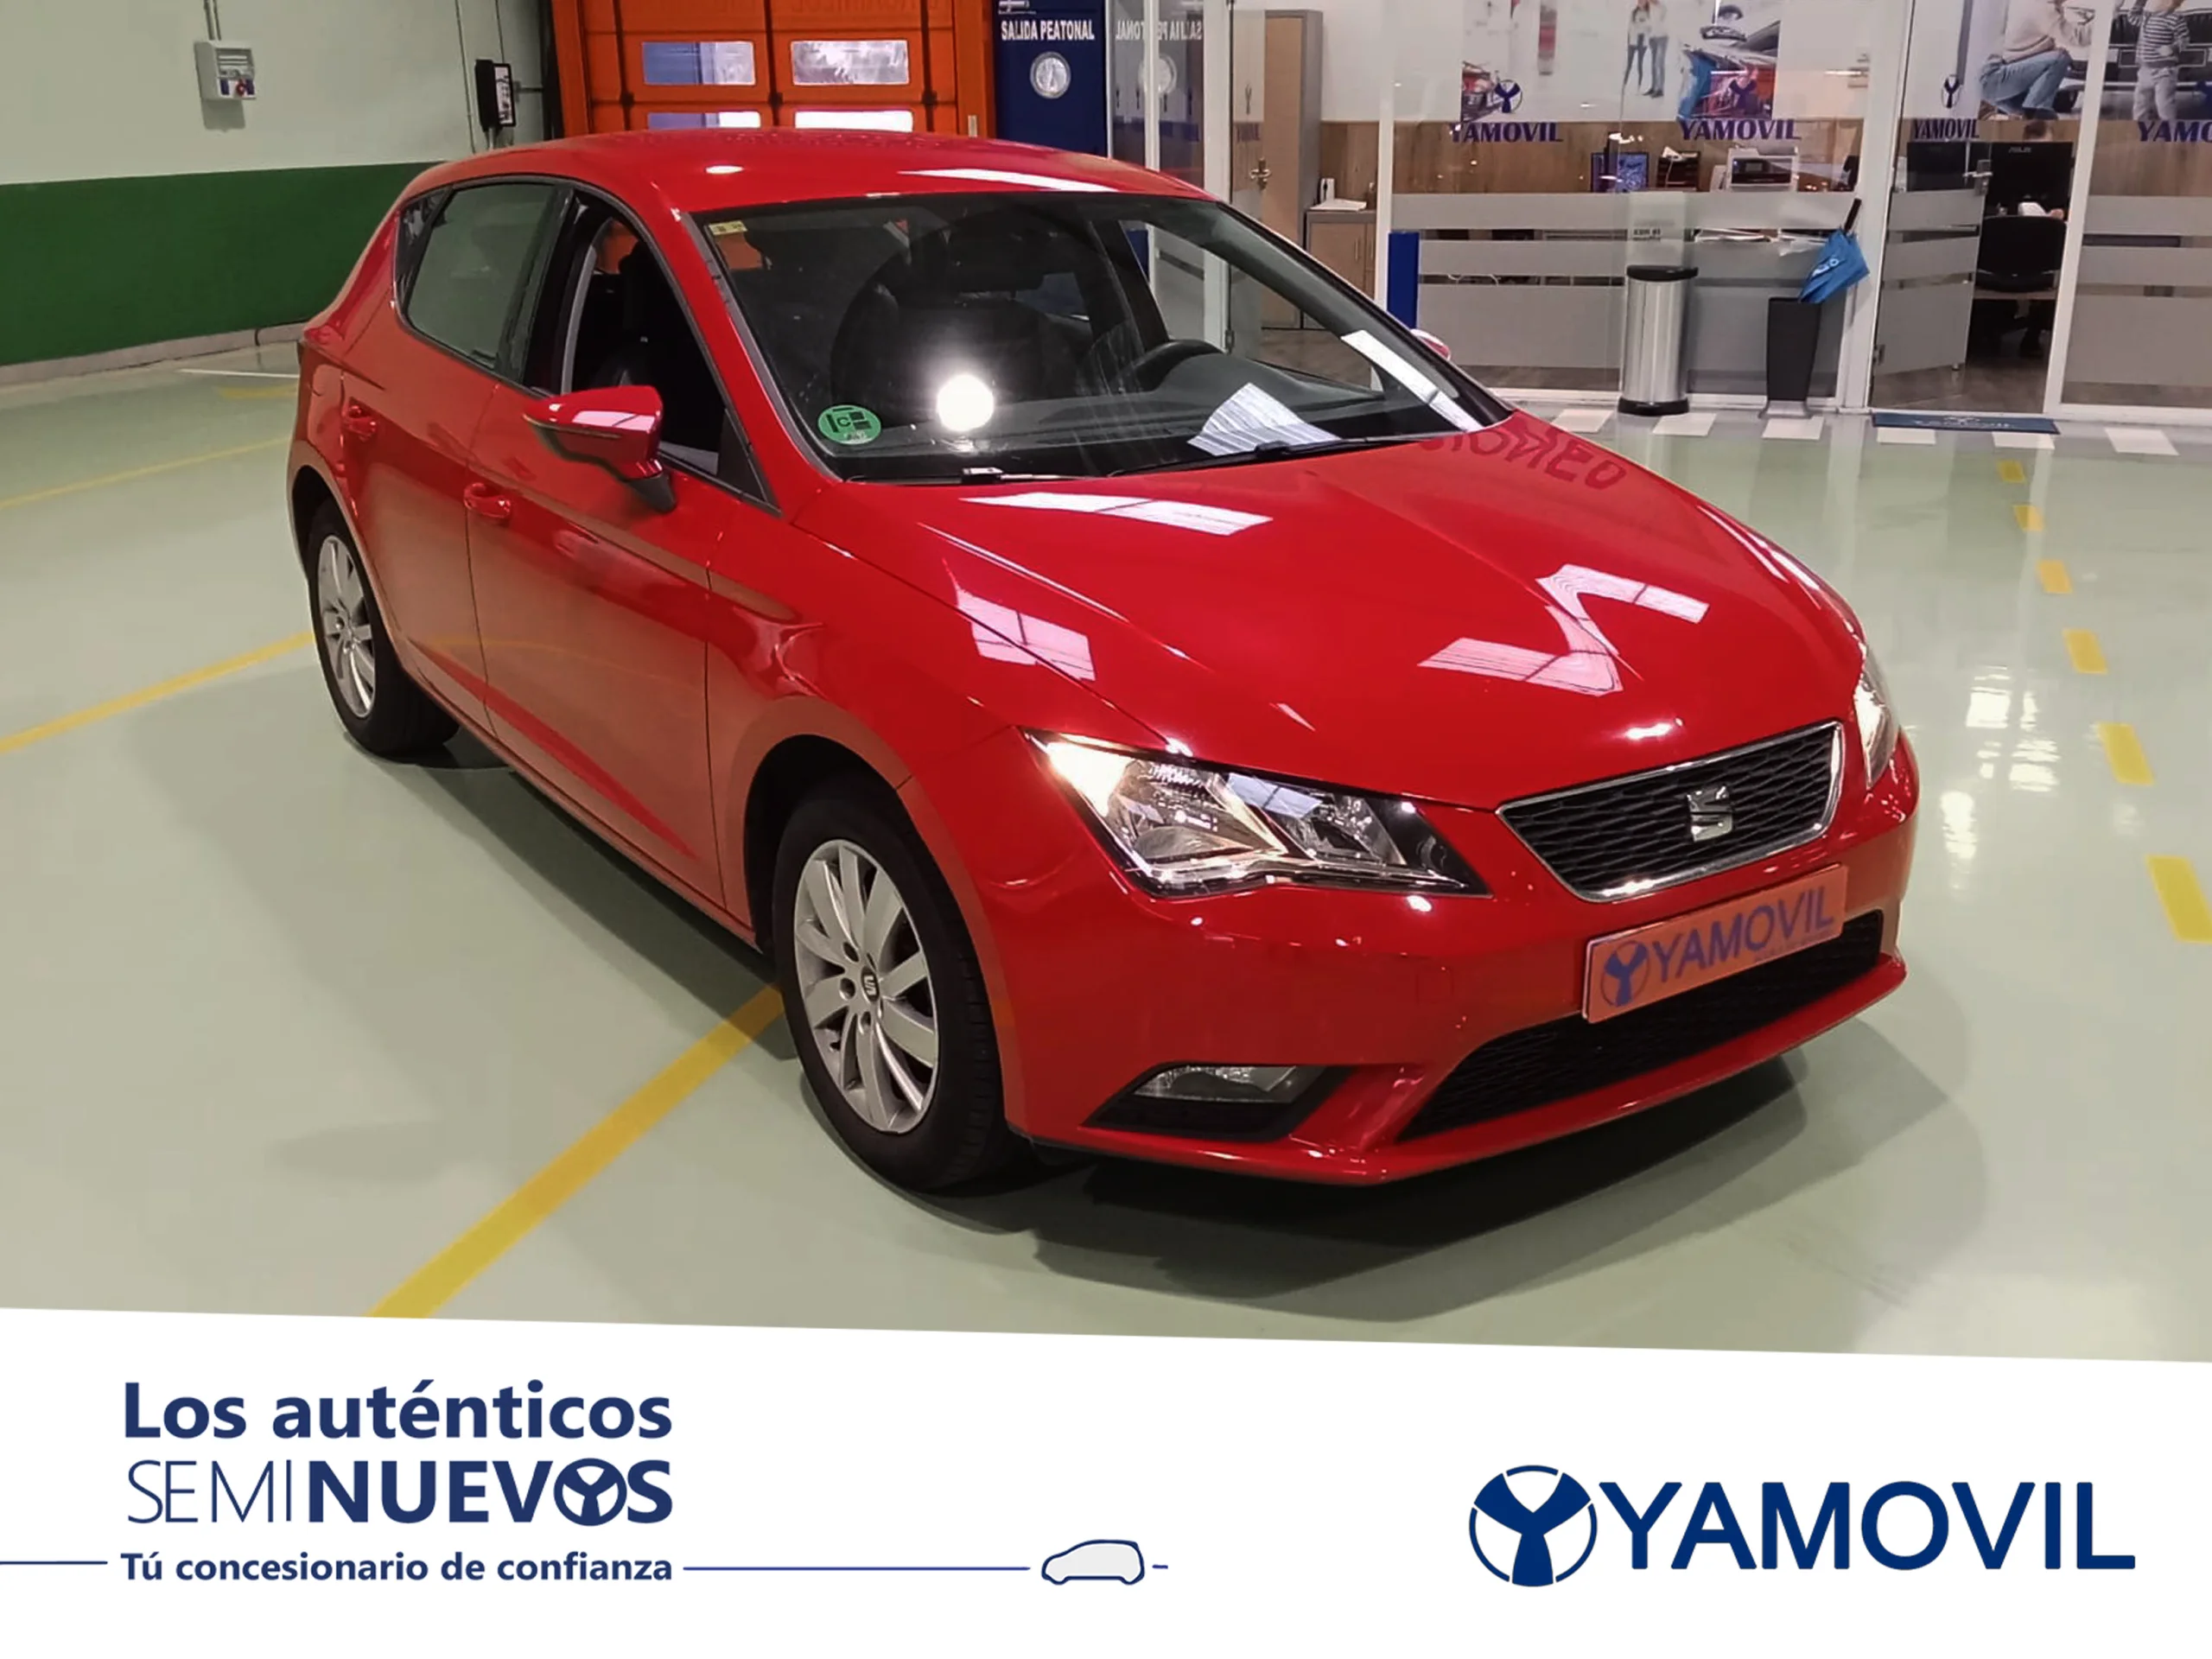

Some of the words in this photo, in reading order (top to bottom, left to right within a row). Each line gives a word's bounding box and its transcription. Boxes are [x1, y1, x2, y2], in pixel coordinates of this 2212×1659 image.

[1001, 20, 1038, 41] SALIDA
[1039, 19, 1096, 41] PEATONAL
[1449, 121, 1565, 143] YAMOVIL
[1679, 118, 1802, 140] YAMOVIL
[1913, 118, 1980, 140] YAMOVIL
[1653, 886, 1834, 983] YAMOVIL
